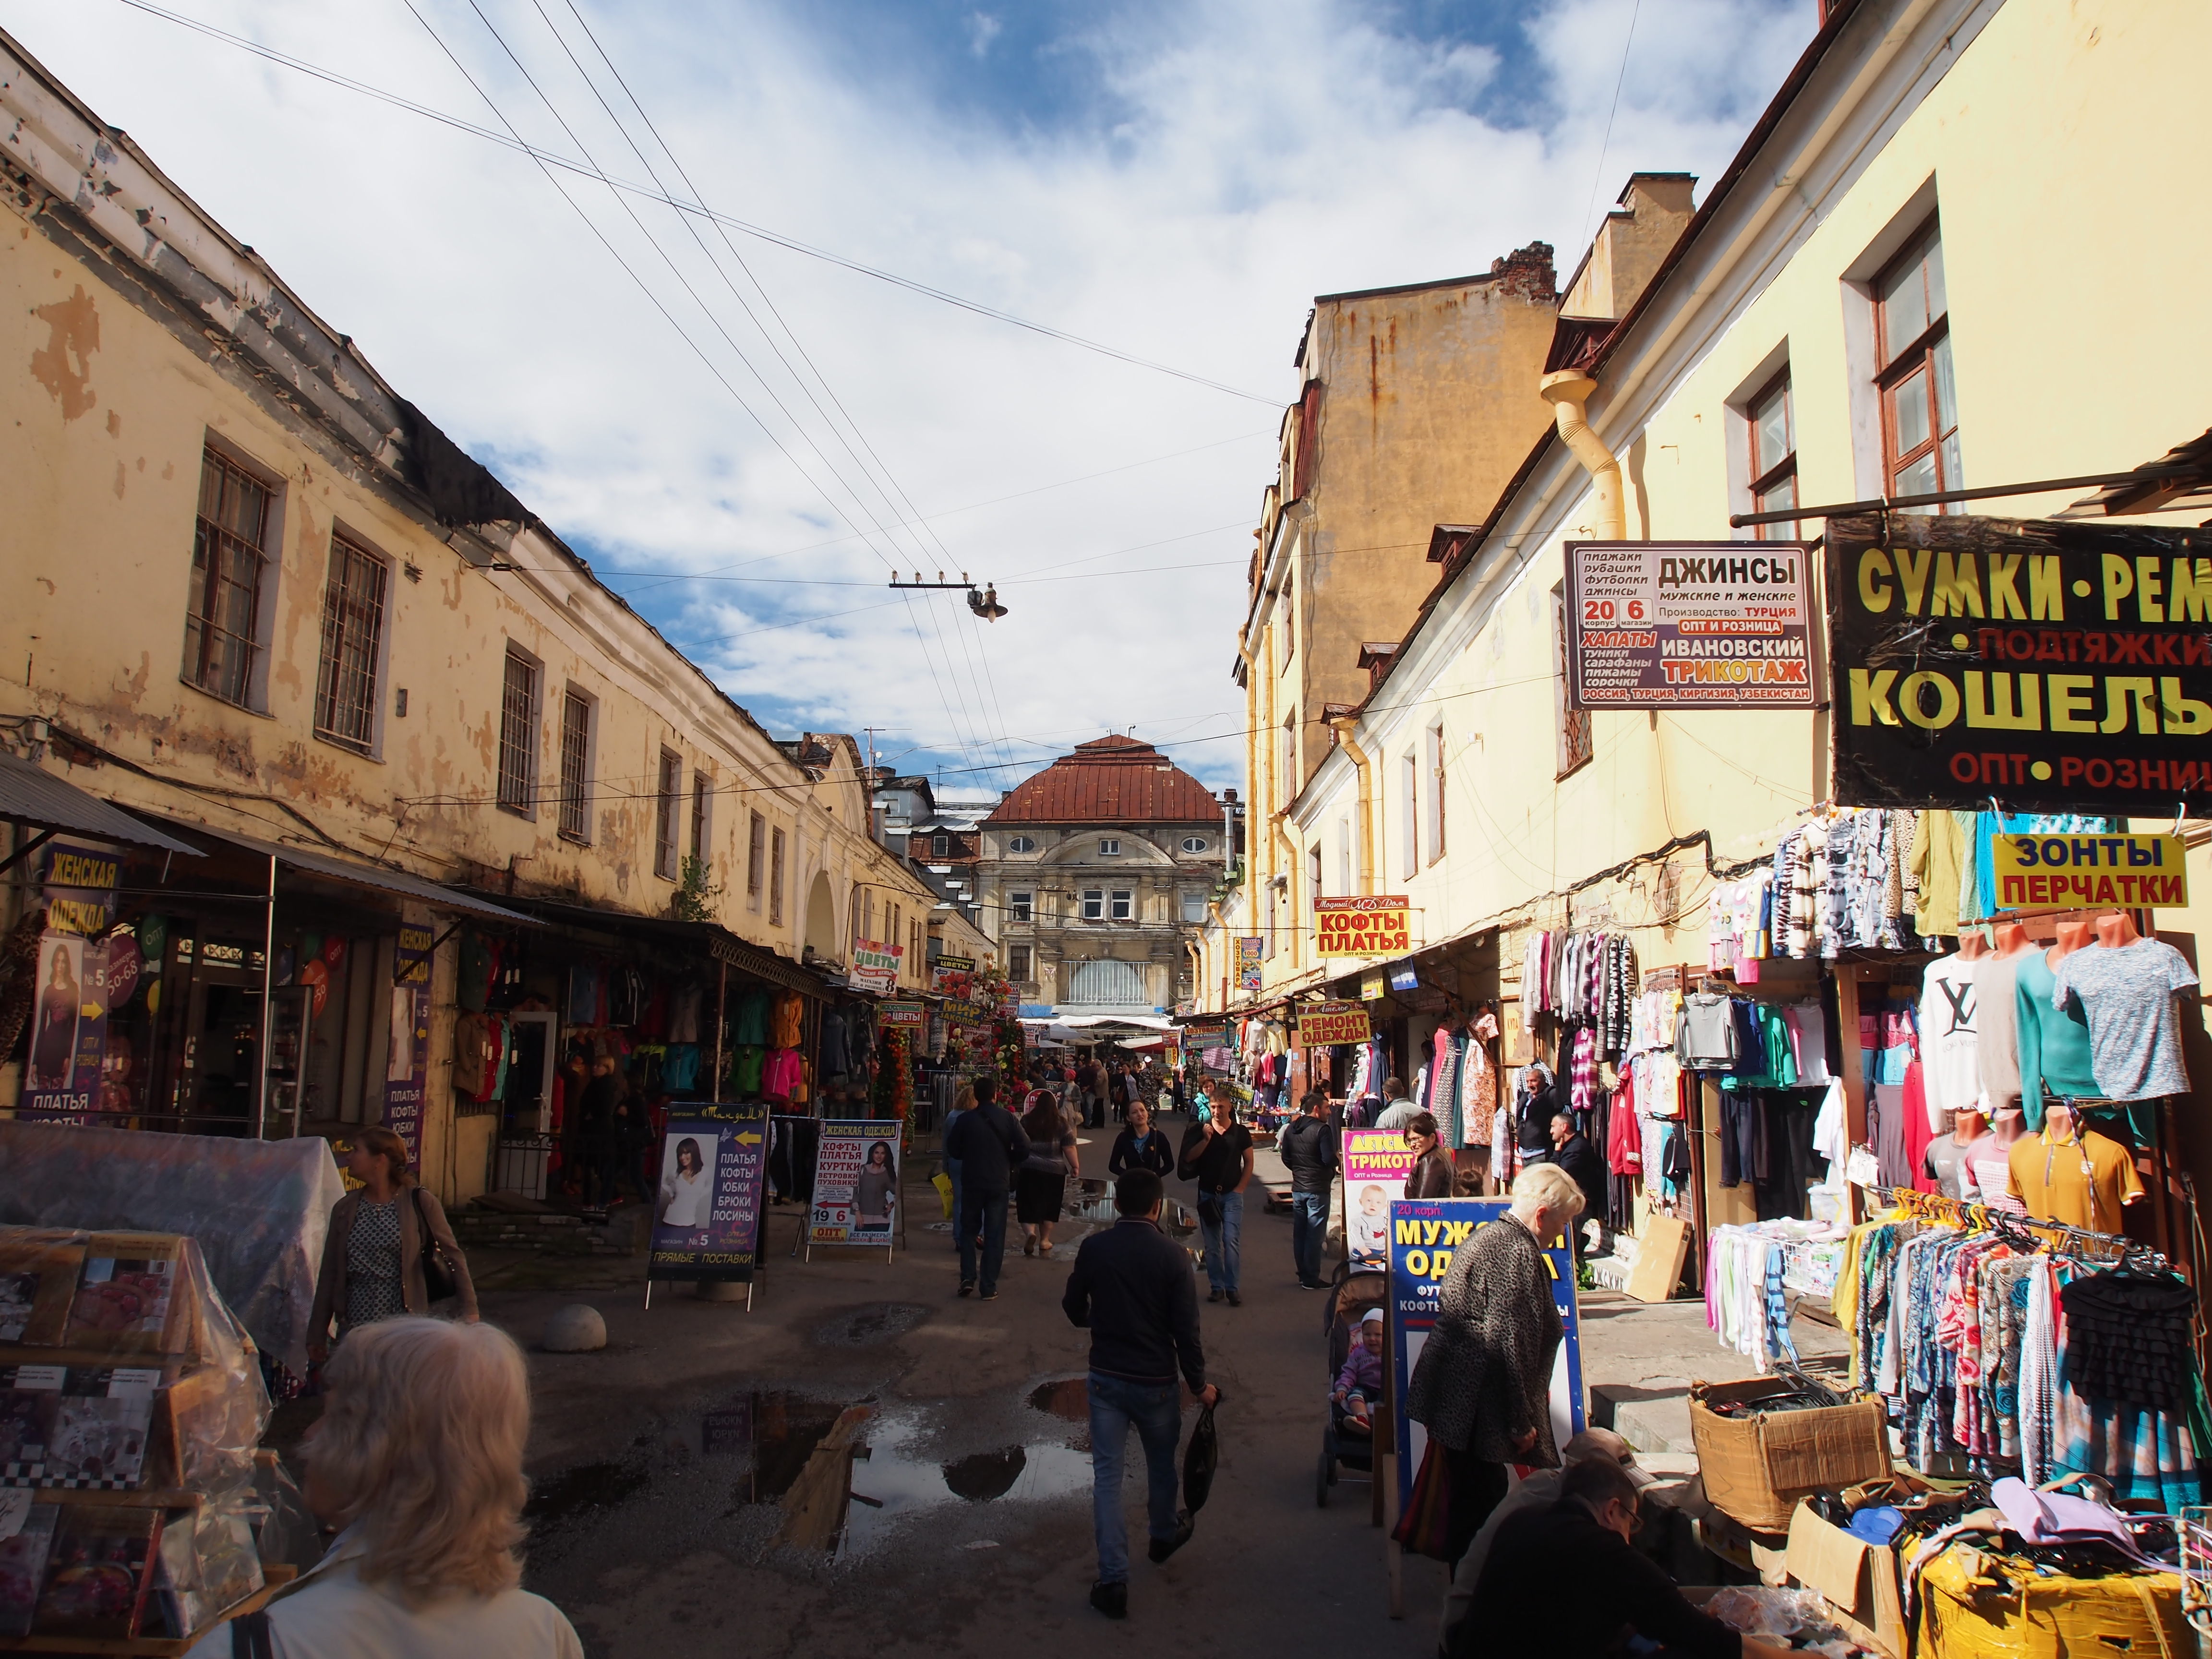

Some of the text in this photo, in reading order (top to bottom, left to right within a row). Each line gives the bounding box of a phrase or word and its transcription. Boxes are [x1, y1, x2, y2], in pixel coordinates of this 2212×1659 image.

[1584, 563, 1642, 573] рубашки
[1658, 557, 1796, 589] ДЖИНСЫ
[1585, 575, 1648, 584] футболки
[1857, 548, 2064, 622] СУМКИ
[1659, 591, 1796, 601] мужские и женские
[1585, 601, 1614, 620] 20
[1628, 600, 1644, 619] 6
[1659, 607, 1796, 619] Производство: ТУРЦИЯ
[1681, 621, 1781, 633] ОПТ И РОЗНИЦА
[1581, 631, 1658, 648] ХАЛАТЫ
[1661, 636, 1804, 657] ИВАНОВСКИЙ
[1978, 627, 2212, 666] ПОДТЯЖКИ
[1585, 649, 1629, 658] туники
[1585, 658, 1652, 668] сарафаны
[1586, 668, 1641, 678] пижамы
[1660, 659, 1807, 684] ТРИКОТАЖ
[1586, 678, 1638, 687] сорочки
[1583, 688, 1809, 700] РОССИЯ, ТУРЦИЯ, КИРГИЗИЯ, УЗБЕКИСТАН
[1849, 668, 2212, 735] КОШЕЛЬ
[1949, 752, 2029, 784] ОПТ
[2016, 838, 2162, 866] ЗОНТЫ
[50, 852, 117, 888] ЖЕНСКАЯ
[2003, 875, 2183, 904] ПЕРЧАТКИ
[1316, 900, 1348, 909] Модный
[1382, 899, 1405, 907] Дом
[49, 898, 105, 938] ОДЕЖДА
[1321, 913, 1405, 932] КОФТЫ
[399, 928, 432, 951] ЖЕНСКАЯ
[1319, 932, 1408, 951] ПЛАТЬЯ
[855, 951, 899, 970] ЦВЕТЫ
[936, 955, 974, 964] ИСКУССТВЕННЫЕ
[940, 961, 970, 970] ЦВЕТЫ
[96, 969, 105, 986] 5
[885, 978, 895, 992] 8
[422, 1005, 428, 1017] 5
[942, 1000, 981, 1019] МИР
[1302, 1003, 1348, 1013] 7 Ателье
[892, 1012, 920, 1022] ЦВЕТЫ
[938, 1011, 980, 1027] ЗАКОЛОК
[1301, 1014, 1366, 1031] РЕМОНТ
[1186, 1026, 1225, 1034] ХОЗТОВАРЫ
[1302, 1027, 1367, 1045] ОДЕЖДЫ
[33, 1093, 89, 1110] ПЛАТЬЯ
[391, 1089, 420, 1102] ПЛАТЬЯ
[391, 1106, 418, 1118] КОФТЫ
[825, 1125, 895, 1138] ЖЕНСКАЯ ОДЕЖДА
[822, 1142, 861, 1151] КОФТЫ
[1350, 1135, 1413, 1153] ДЕТСК
[721, 1154, 757, 1165] ПЛАТЬЯ
[820, 1151, 862, 1160] ПЛАТЬЯ
[721, 1167, 754, 1178] КОФТЫ
[819, 1162, 861, 1171] КУРТКИ
[722, 1182, 749, 1192] ЮБКИ
[718, 1196, 751, 1207] БРЮКИ
[712, 1210, 754, 1221] ЛОСИНЫ
[813, 1210, 829, 1221] 19
[836, 1210, 845, 1222] 6
[1397, 1204, 1444, 1217] 20 корп.
[817, 1228, 841, 1237] ОПТ
[700, 1235, 709, 1246] 5
[653, 1252, 752, 1263] ПРЯМЫЕ ПОСТАВКИ
